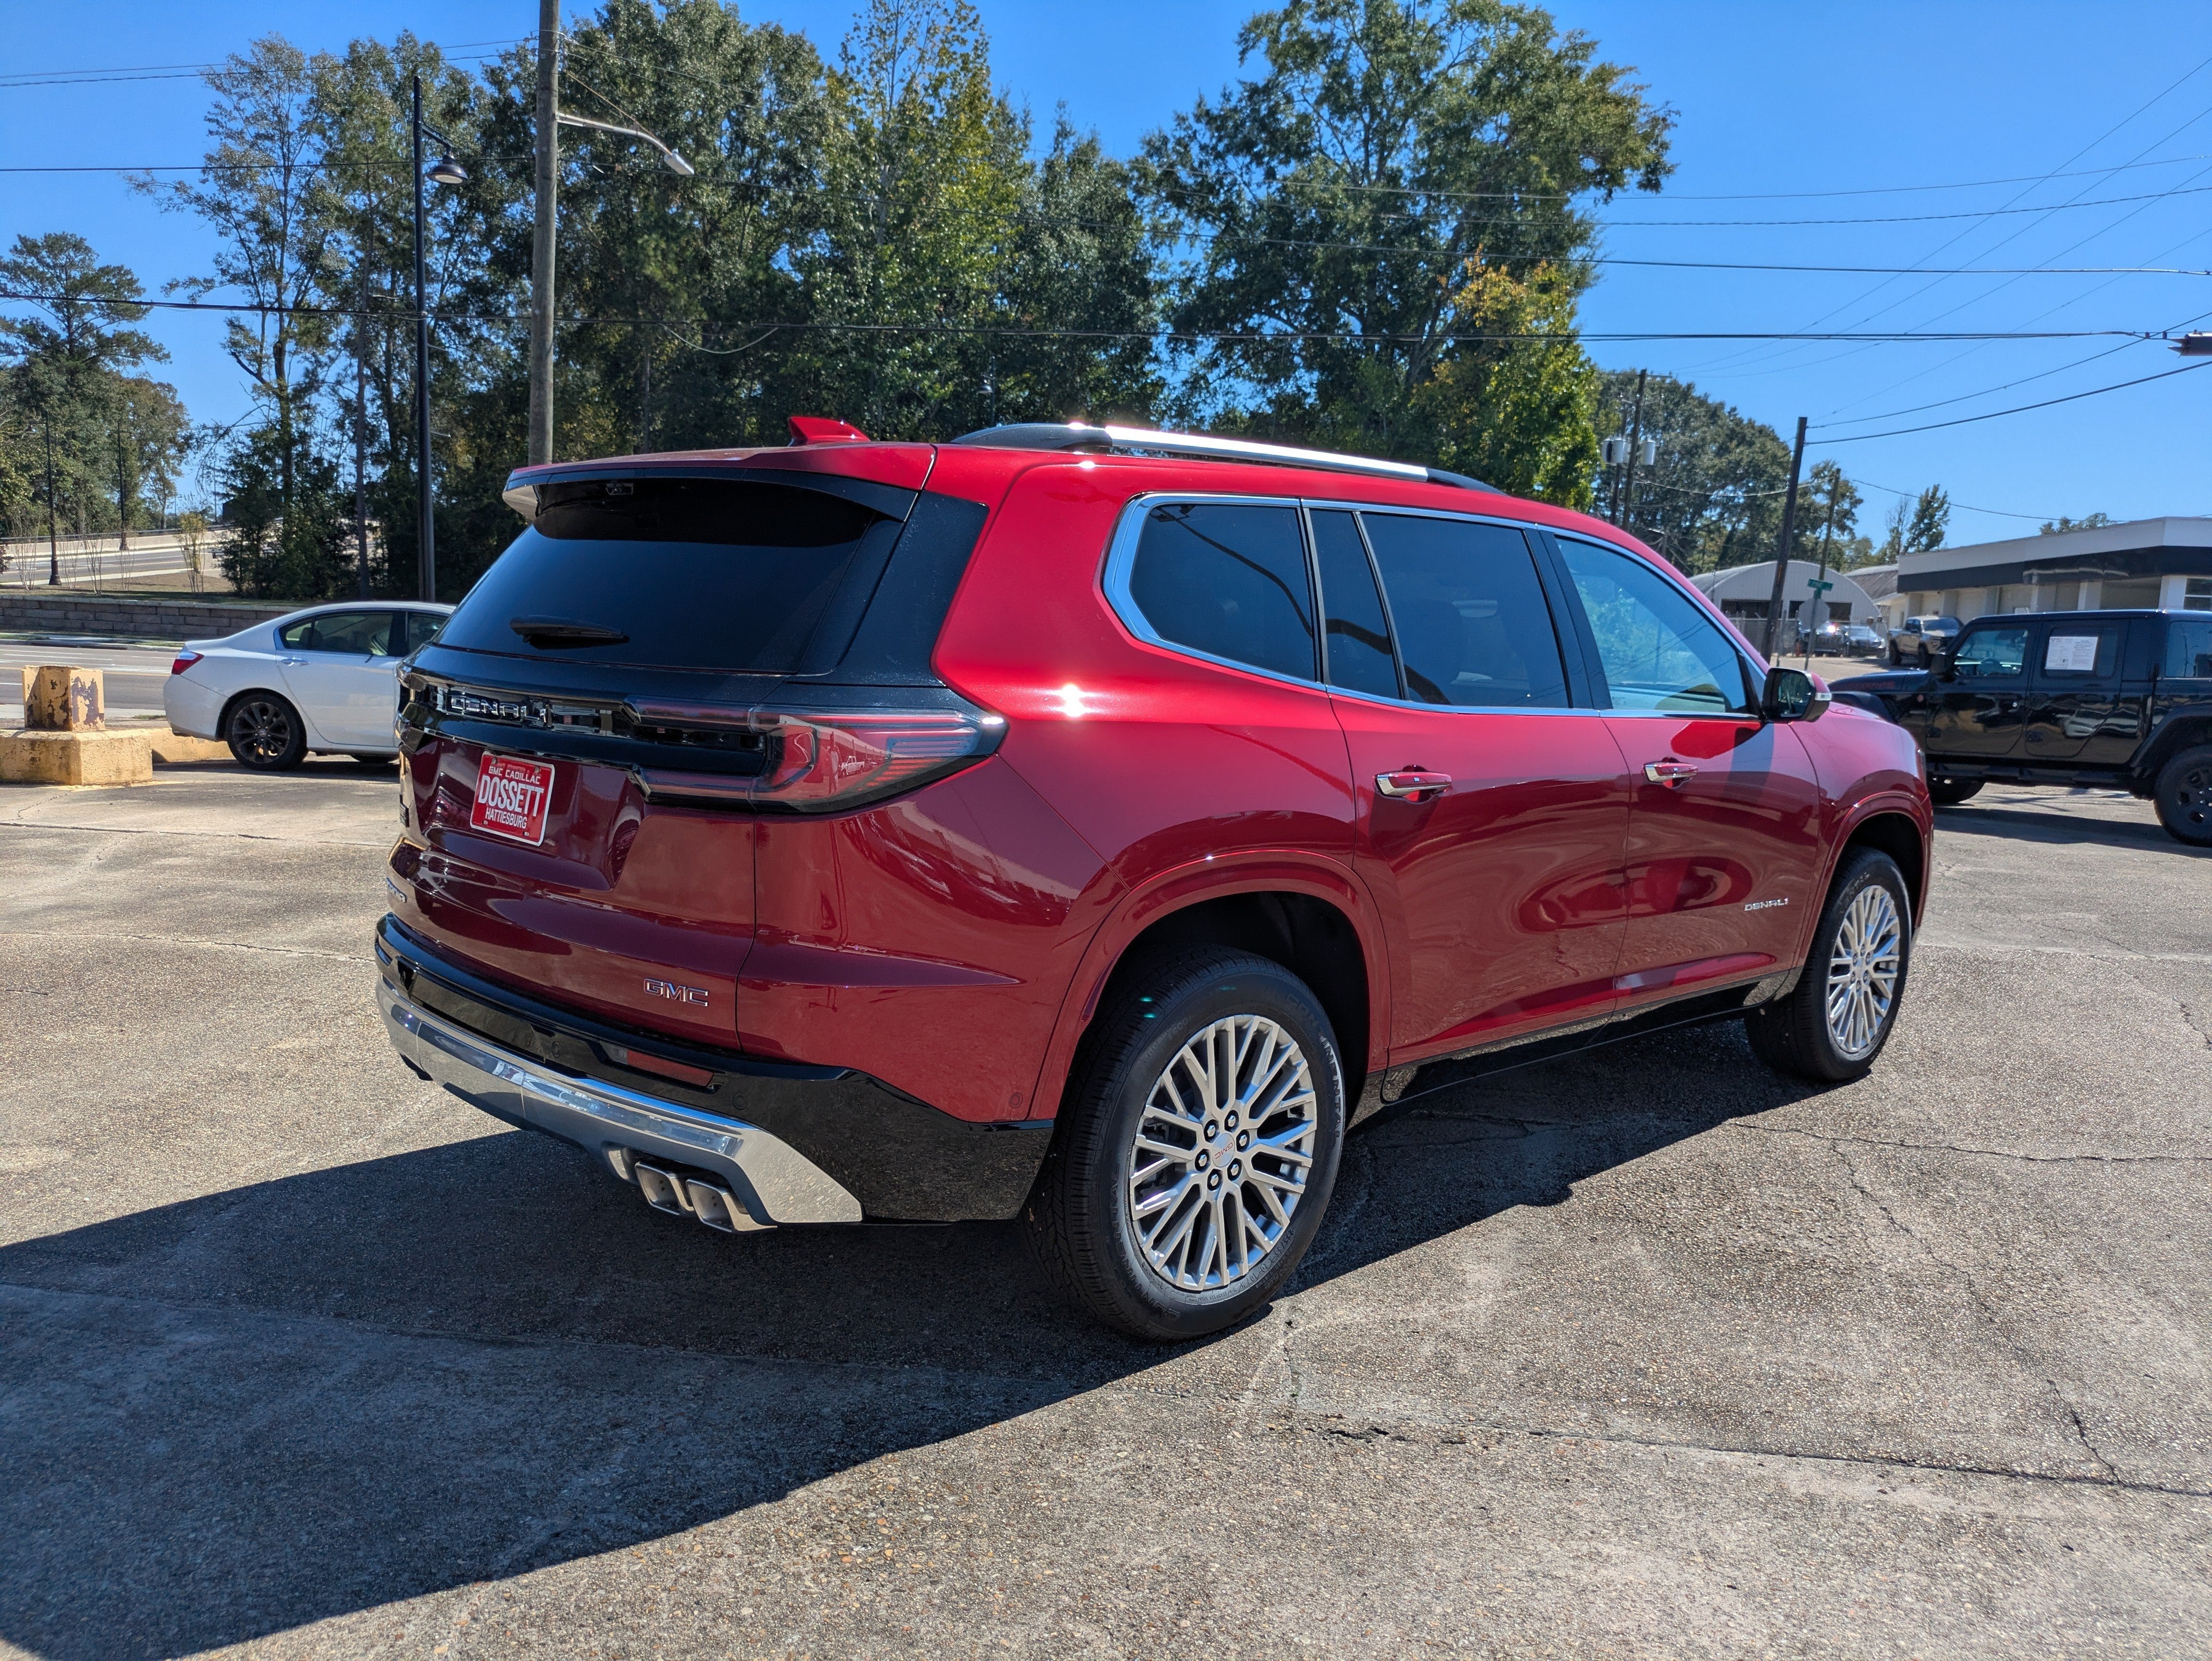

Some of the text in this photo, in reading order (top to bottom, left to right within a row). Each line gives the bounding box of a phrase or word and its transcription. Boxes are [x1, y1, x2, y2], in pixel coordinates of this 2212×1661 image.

[451, 695, 546, 723] DENALI
[488, 766, 541, 784] GMC CADILLAC
[478, 775, 544, 817] DOSSETT
[485, 807, 528, 829] HATTIESBURG
[1744, 898, 1789, 911] DENALI
[643, 978, 708, 1007] GMC
[1214, 1142, 1233, 1160] GMC
